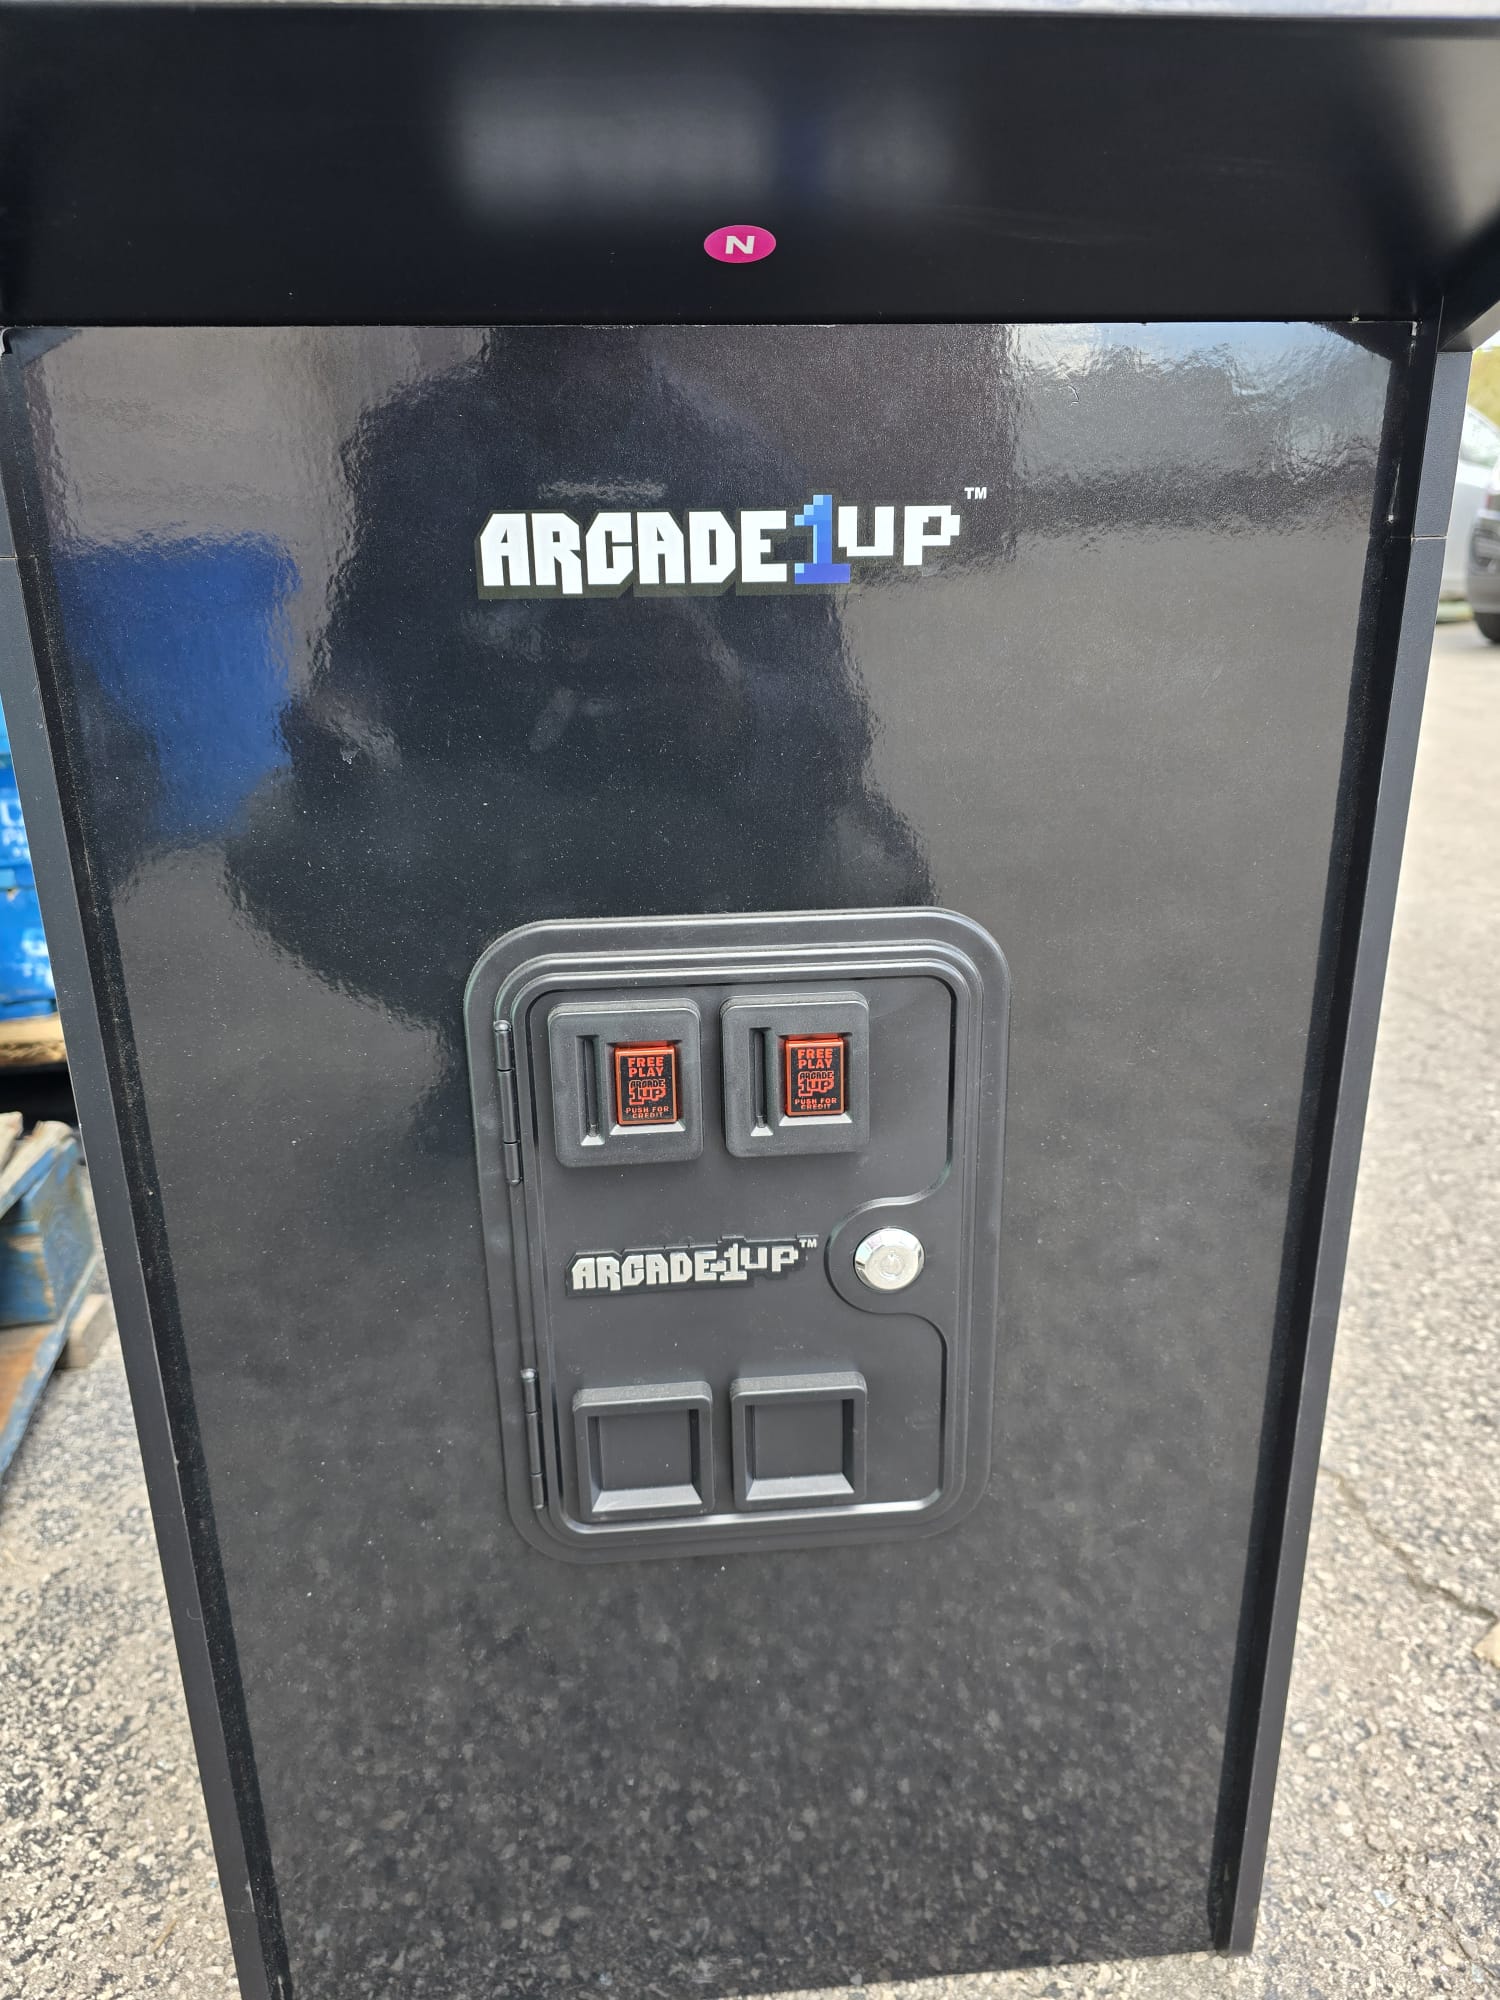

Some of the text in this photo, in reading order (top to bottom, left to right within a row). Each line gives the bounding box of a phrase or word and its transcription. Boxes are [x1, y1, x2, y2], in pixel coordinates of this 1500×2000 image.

[725, 235, 755, 254] N
[798, 1049, 833, 1059] FREE
[628, 1057, 664, 1068] FREE
[798, 1058, 832, 1069] PLAY
[628, 1067, 664, 1078] PLAY
[799, 1071, 833, 1080] ARCADE
[798, 1079, 834, 1097] 1UP
[629, 1087, 667, 1105] 1UP
